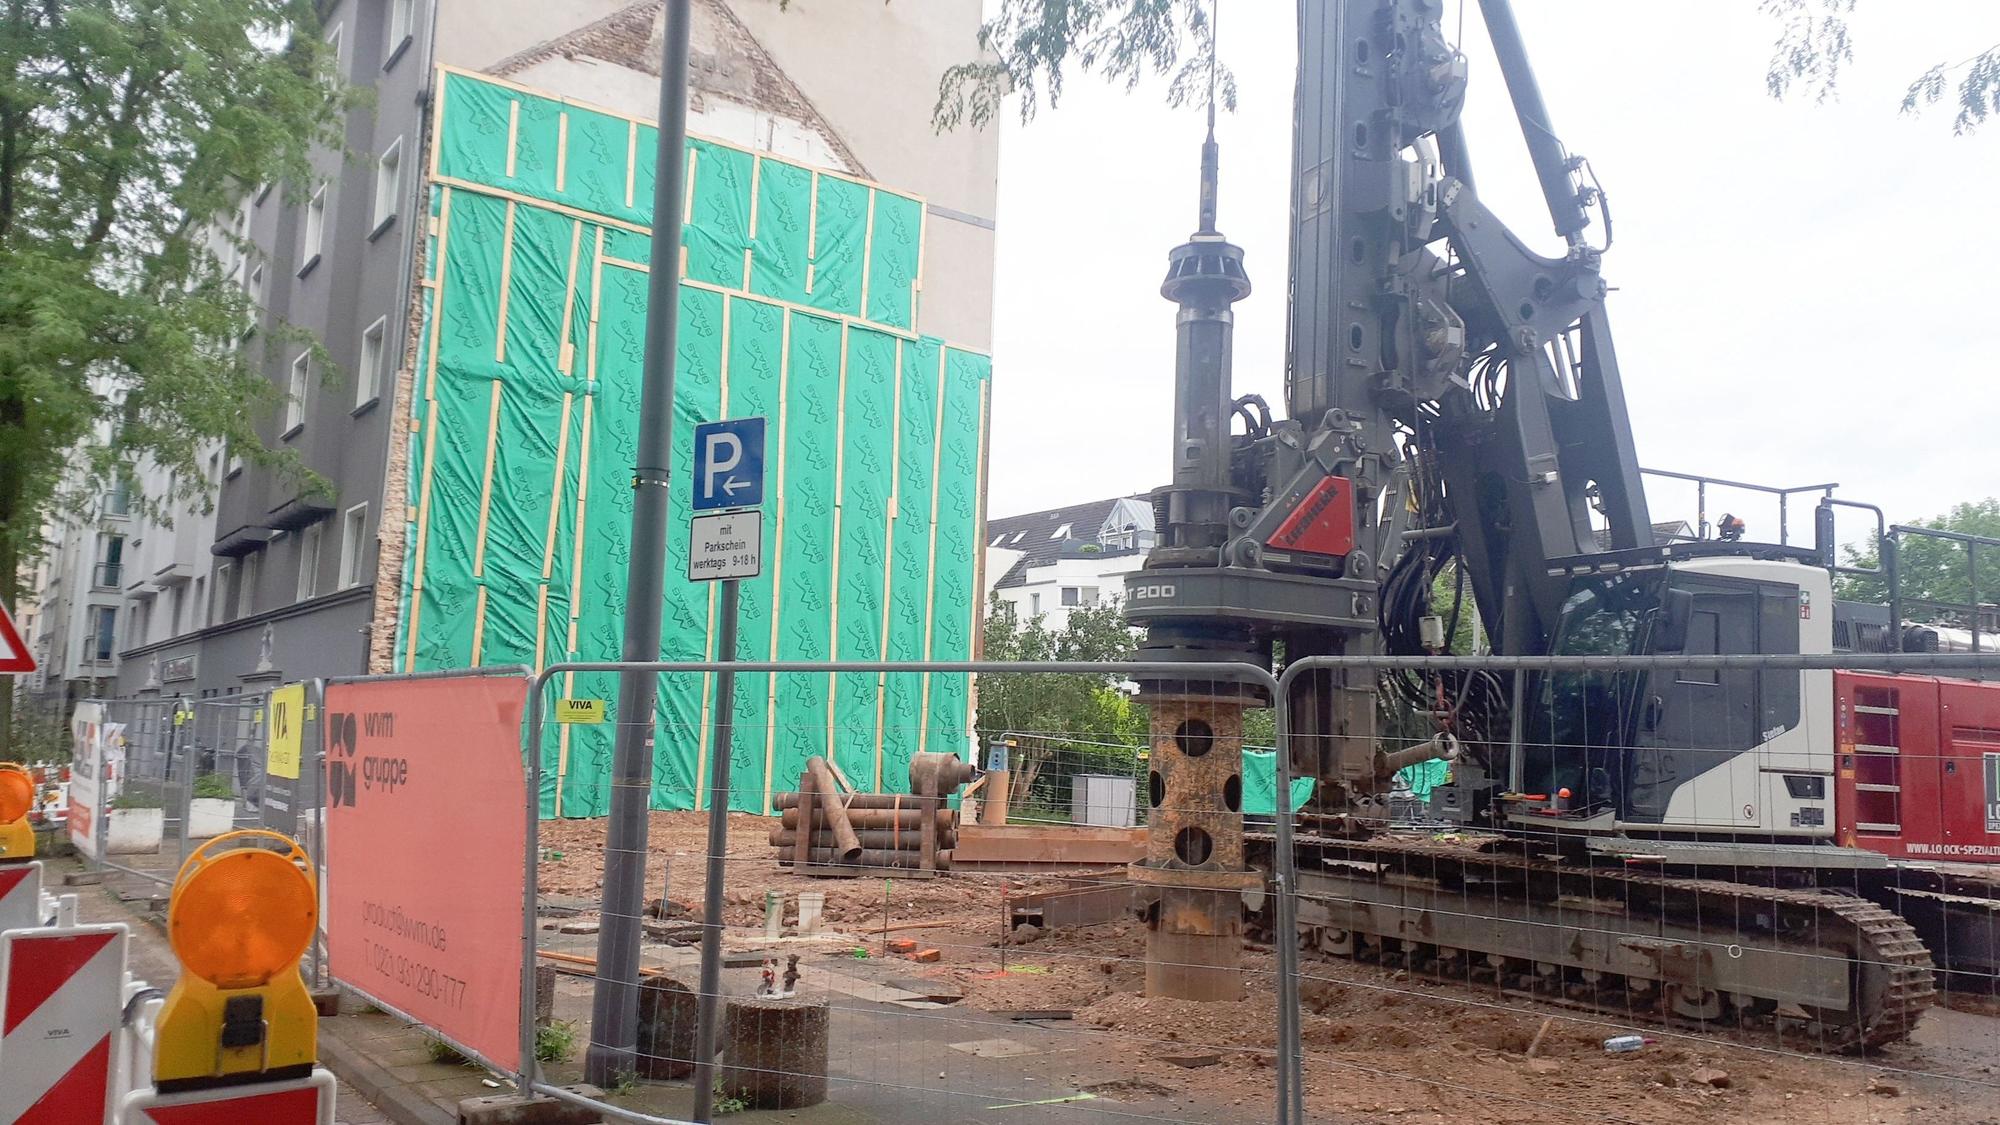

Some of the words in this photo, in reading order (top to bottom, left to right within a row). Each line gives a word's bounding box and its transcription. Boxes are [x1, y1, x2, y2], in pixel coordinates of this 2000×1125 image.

[704, 432, 743, 499] P
[720, 525, 732, 536] mit
[704, 539, 746, 553] Parkschein
[693, 557, 726, 570] werktags
[733, 554, 749, 566] 9-18
[750, 552, 756, 565] h
[1136, 585, 1176, 600] 200
[798, 672, 817, 706] BRAA
[853, 672, 873, 704] BRAA
[569, 700, 593, 710] VIVA
[363, 711, 394, 738] wvm
[363, 755, 409, 794] gruppe
